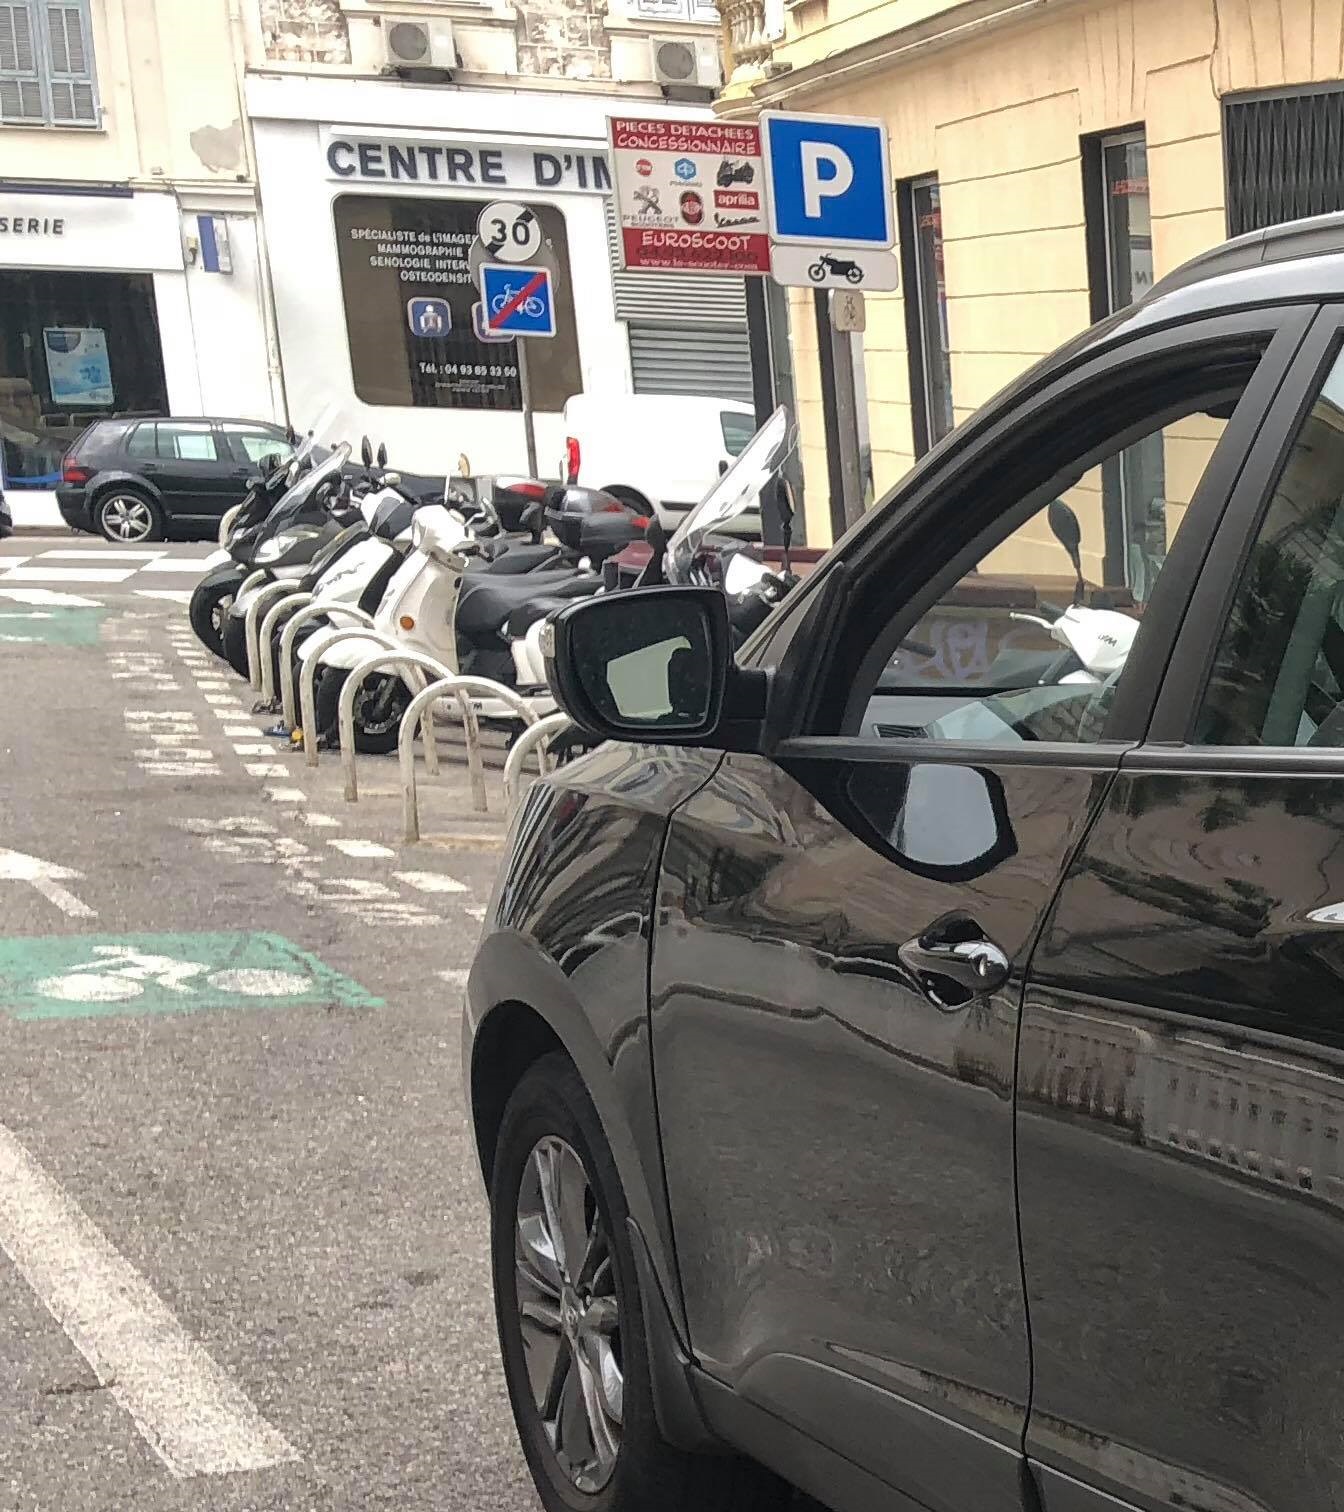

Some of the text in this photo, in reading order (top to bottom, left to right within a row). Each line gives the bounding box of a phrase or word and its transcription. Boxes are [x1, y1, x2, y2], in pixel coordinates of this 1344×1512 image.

[616, 121, 754, 139] PIECES DETACHEES
[617, 134, 756, 154] CONCESSIONNAIRE
[327, 141, 506, 183] CENTRE
[800, 141, 854, 218] P
[351, 228, 416, 241] SPÉCIALISTE
[490, 218, 530, 246] 30
[642, 231, 751, 250] EUROSCOOT
[378, 243, 463, 257] MAMMOGRAPHIE
